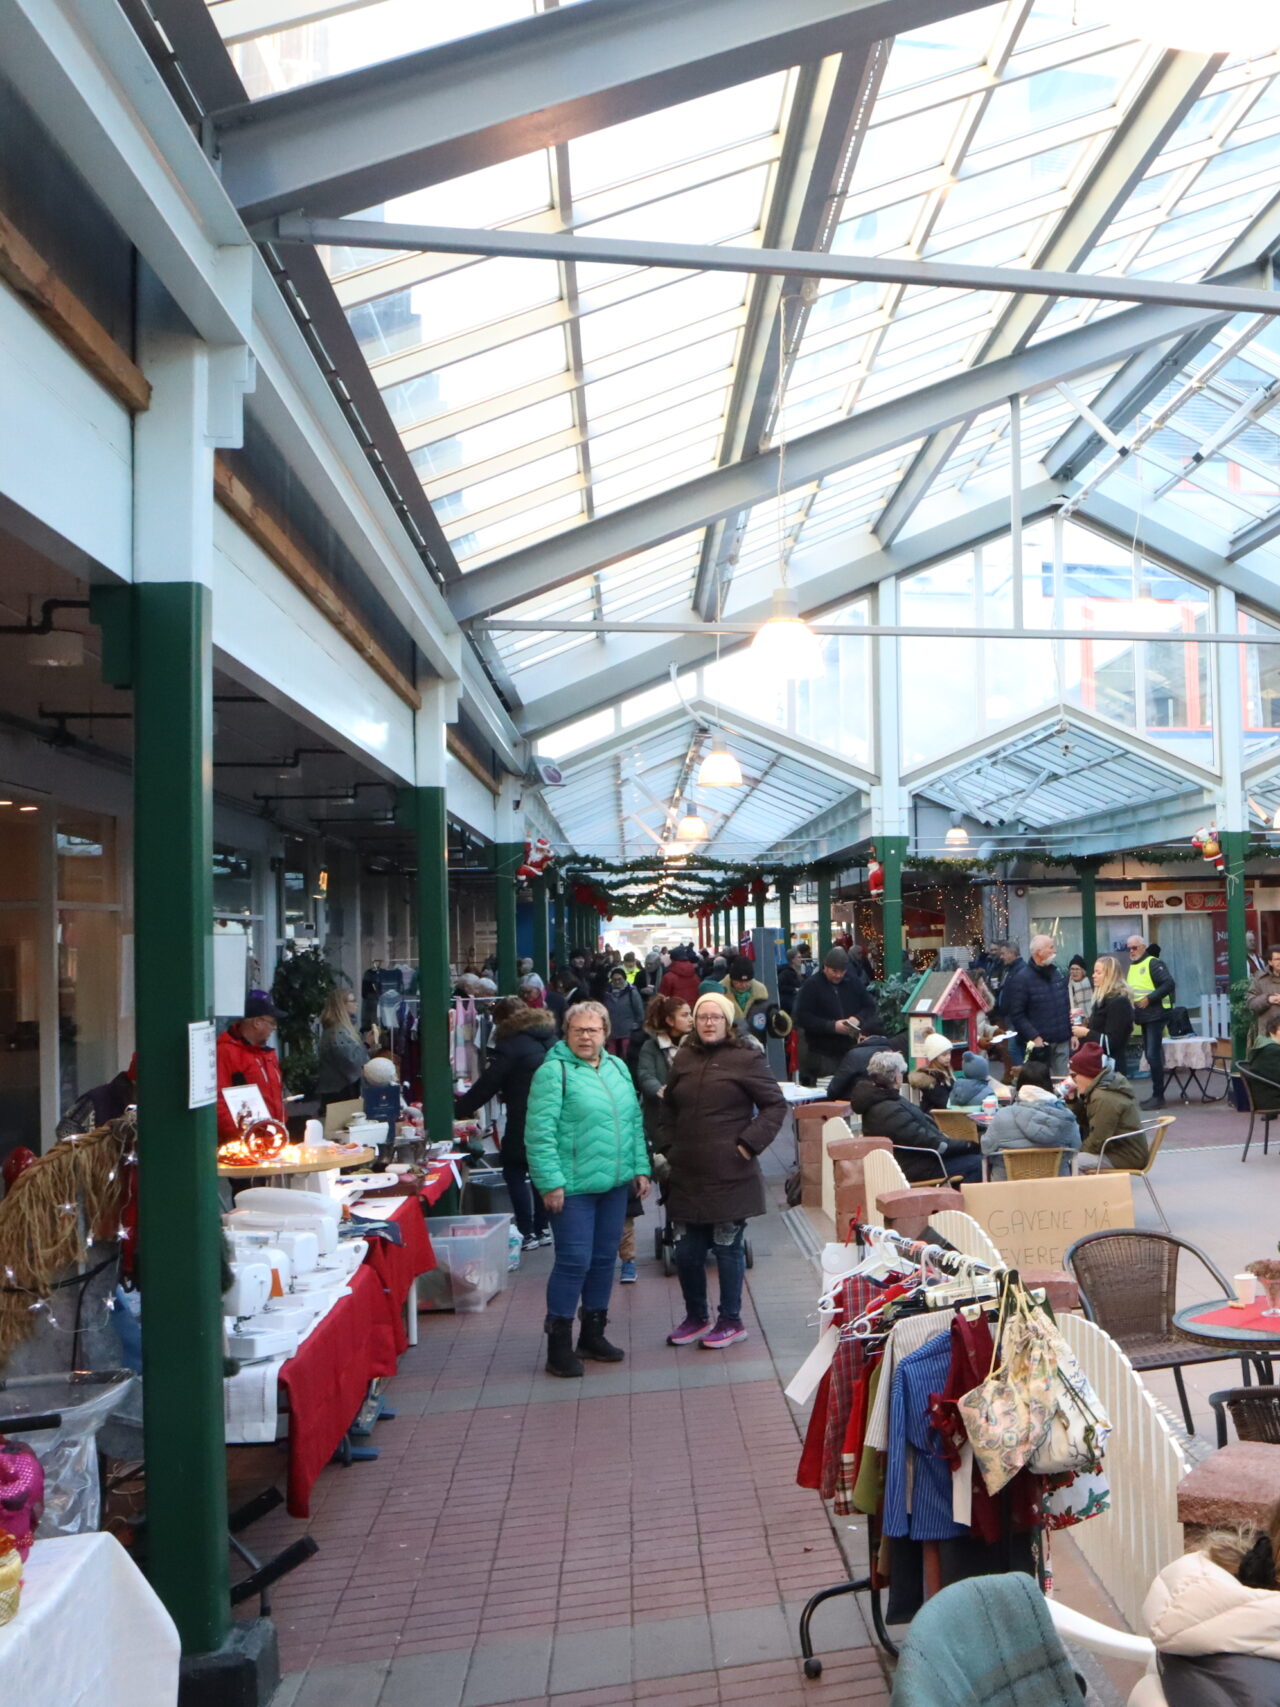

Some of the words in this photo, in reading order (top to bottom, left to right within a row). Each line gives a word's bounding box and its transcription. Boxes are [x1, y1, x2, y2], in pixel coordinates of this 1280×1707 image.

[987, 1208, 1073, 1239] GAVENE
[1084, 1201, 1112, 1229] MÅ
[999, 1246, 1066, 1266] EVERE
